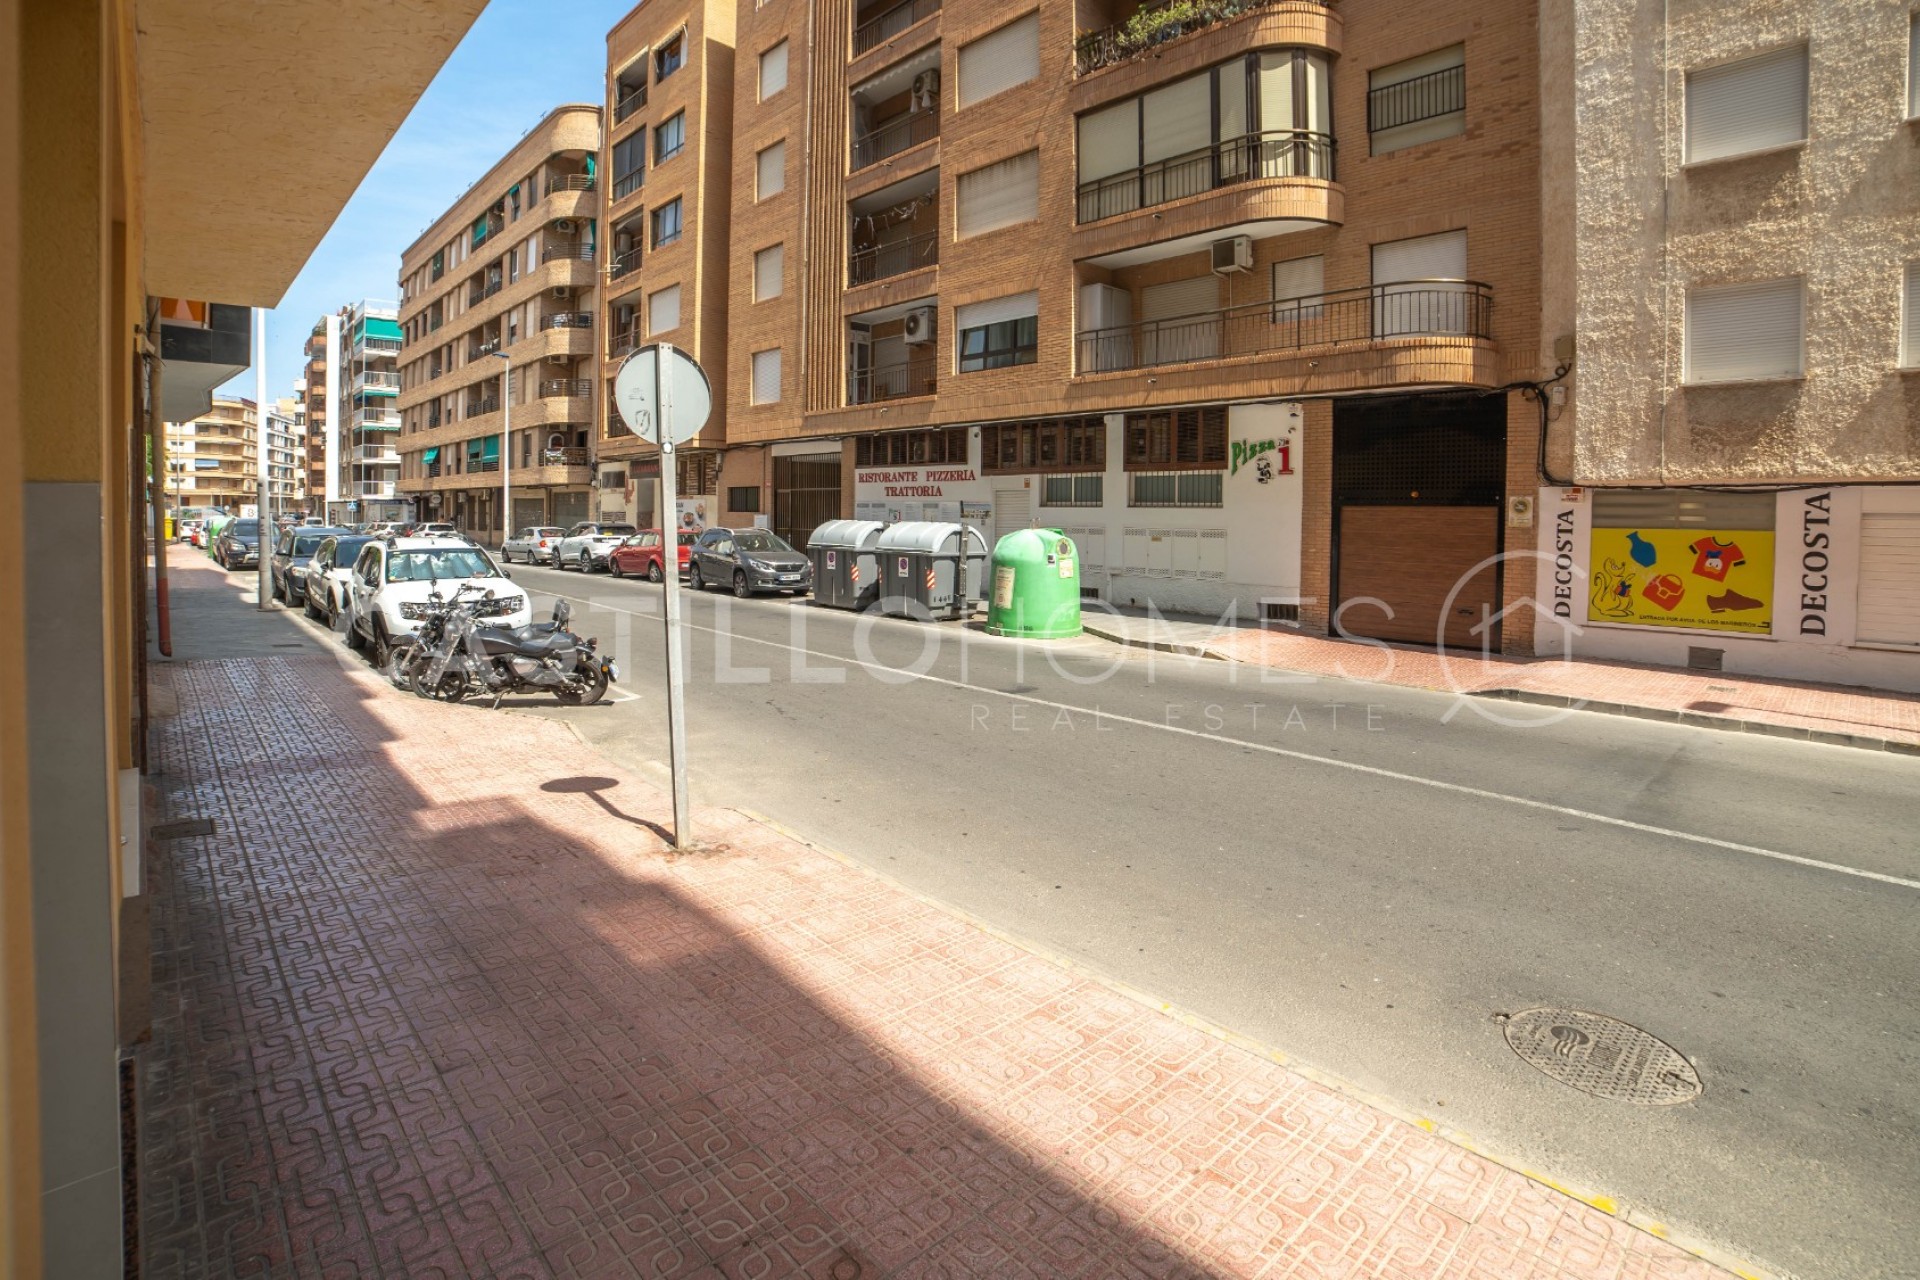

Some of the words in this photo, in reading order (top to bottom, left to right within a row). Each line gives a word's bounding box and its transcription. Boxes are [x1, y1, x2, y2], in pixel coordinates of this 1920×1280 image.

[1231, 438, 1276, 476] Pizza
[1278, 446, 1294, 475] 1
[858, 472, 918, 483] RISTORANTE
[926, 470, 976, 482] PIZZERIA
[884, 486, 943, 497] TRATTORIA
[1553, 509, 1574, 618] DECOSTA
[1800, 491, 1831, 636] DECOSTA
